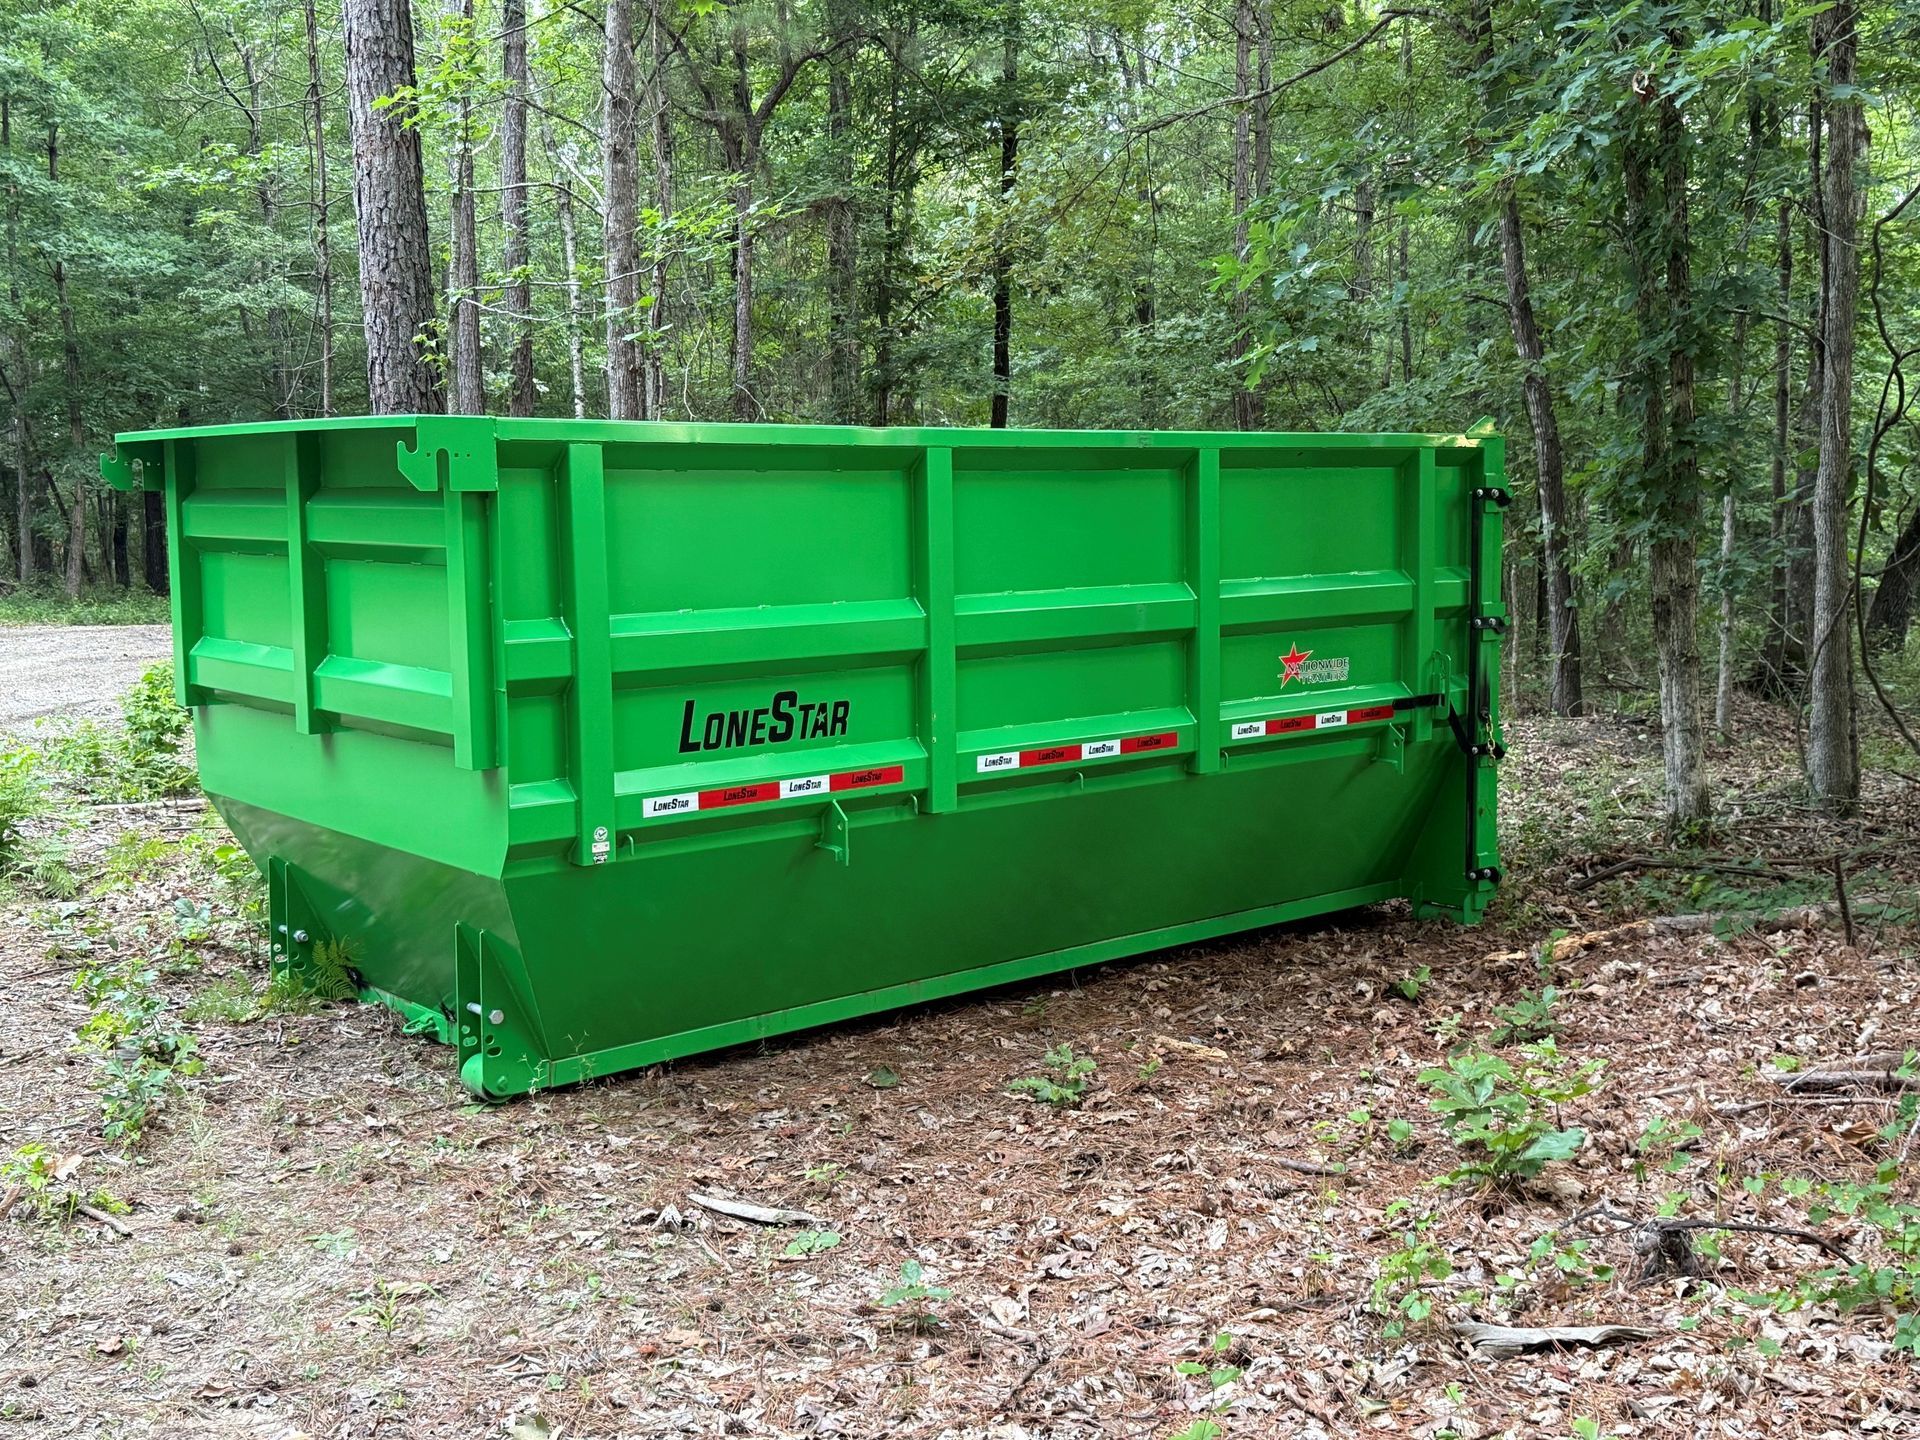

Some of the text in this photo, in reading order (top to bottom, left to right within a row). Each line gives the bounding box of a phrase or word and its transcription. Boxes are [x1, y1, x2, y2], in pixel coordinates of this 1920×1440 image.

[1287, 657, 1349, 673] NATIONWIDE
[678, 690, 850, 753] LONESTAR
[1237, 724, 1260, 735] LONESTAR
[1321, 714, 1342, 725] LONESTAR
[984, 756, 1013, 768] LONESTAR
[1088, 744, 1114, 755] LONESTAR
[653, 771, 882, 812] LONESTAR LONESTAR LONESTAR LONESTAR
